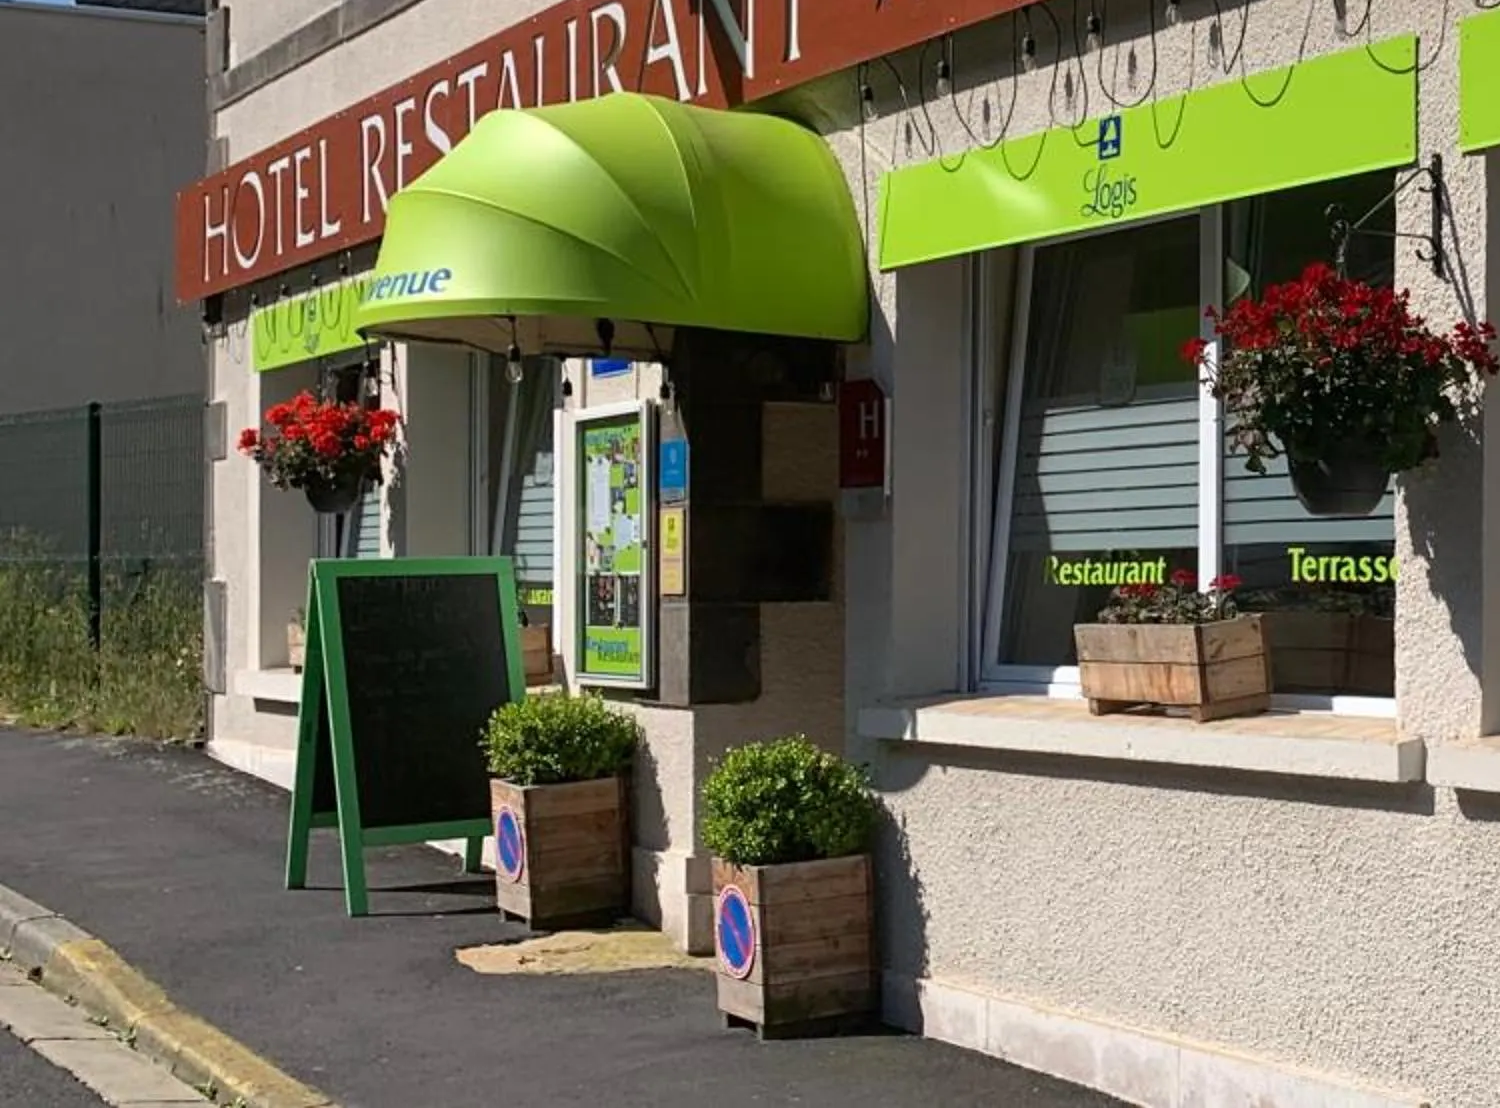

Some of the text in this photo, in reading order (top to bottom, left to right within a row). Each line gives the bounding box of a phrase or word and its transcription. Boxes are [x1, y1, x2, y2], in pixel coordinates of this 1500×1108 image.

[204, 139, 341, 282] HOTEL
[1080, 163, 1137, 218] Logis
[860, 400, 879, 439] H
[1043, 555, 1167, 585] Restaurant
